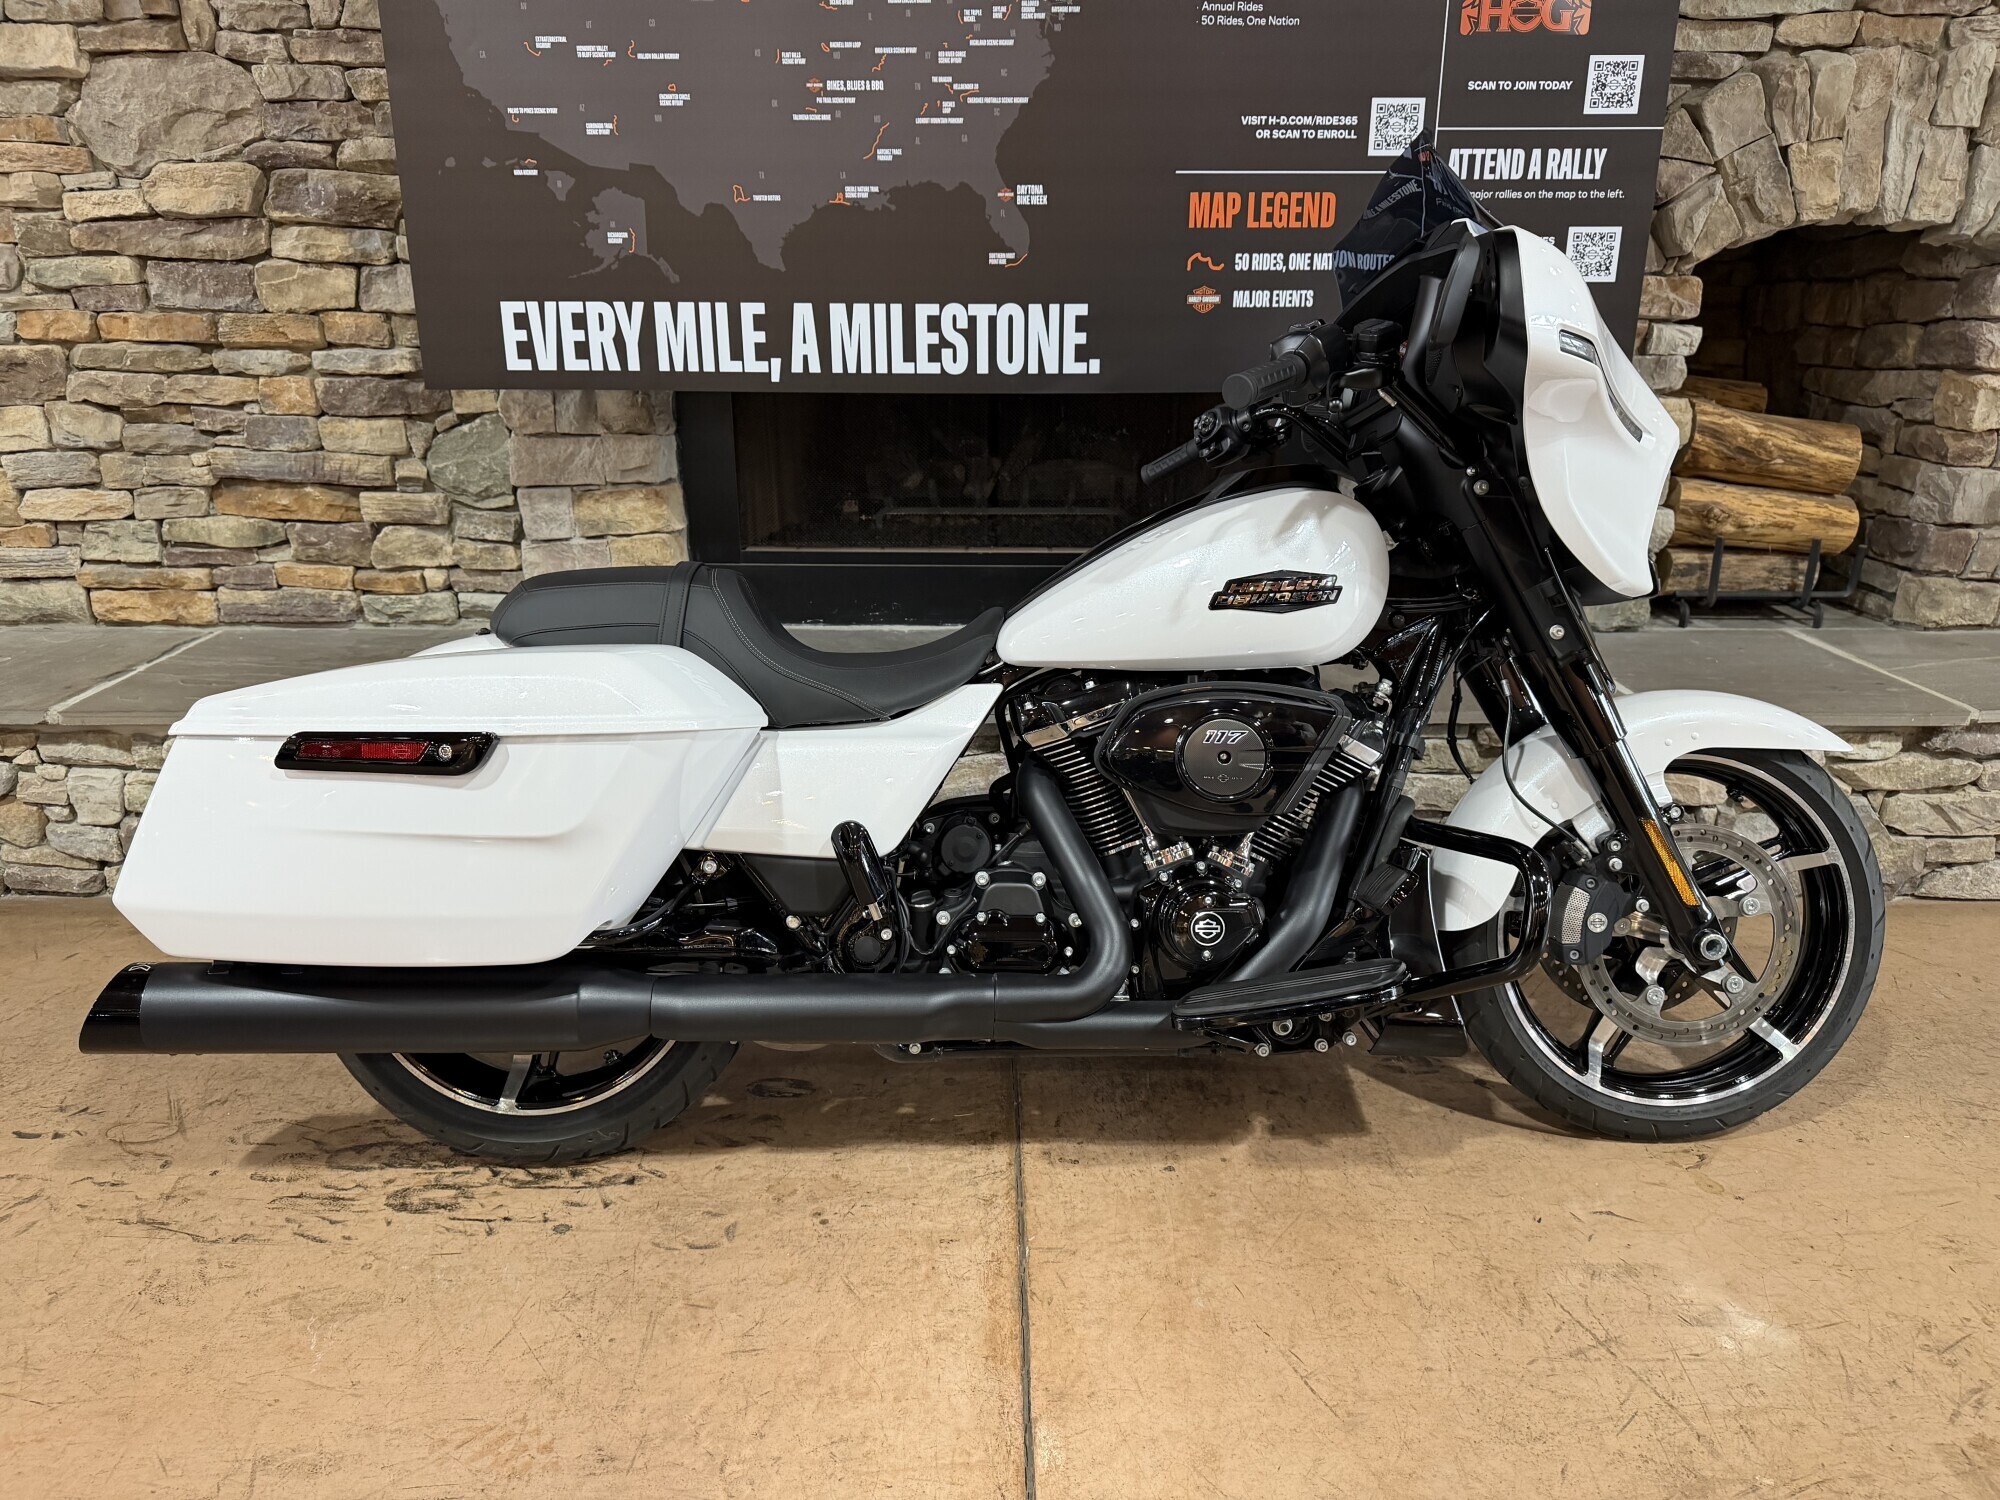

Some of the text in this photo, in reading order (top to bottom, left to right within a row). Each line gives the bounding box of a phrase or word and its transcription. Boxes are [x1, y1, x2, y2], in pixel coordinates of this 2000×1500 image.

[1201, 2, 1264, 11] Annual Rides
[1201, 15, 1300, 27] 50 Rides, One Nation
[826, 80, 846, 91] BIKES,
[846, 80, 864, 91] BLUES
[865, 80, 871, 91] &
[1467, 80, 1573, 90] SCAN TO JOIN TODAY
[1241, 115, 1358, 126] VISIT H-D.COM/RIDE365
[1256, 130, 1357, 139] OR SCAN TO ENROLL
[1448, 148, 1607, 180] ATTEND A RALLY
[1016, 184, 1043, 195] DAYTONA
[1495, 189, 1522, 199] rallies
[1524, 191, 1536, 199] on
[1538, 189, 1554, 199] the
[1555, 191, 1575, 200] map
[1578, 189, 1587, 199] to
[1590, 189, 1605, 199] the
[1607, 189, 1625, 199] left.
[1017, 195, 1048, 205] BIKE WEEK
[1188, 191, 1337, 228] MAP LEGEND
[1234, 253, 1249, 271] 50
[1251, 253, 1286, 272] RIDES,
[1289, 253, 1311, 271] ONE
[1312, 249, 1357, 271] NATION
[1232, 290, 1314, 308] MAJOR EVENTS
[500, 301, 1101, 383] EVERY MILE, A MILESTONE.
[1203, 729, 1249, 744] 117
